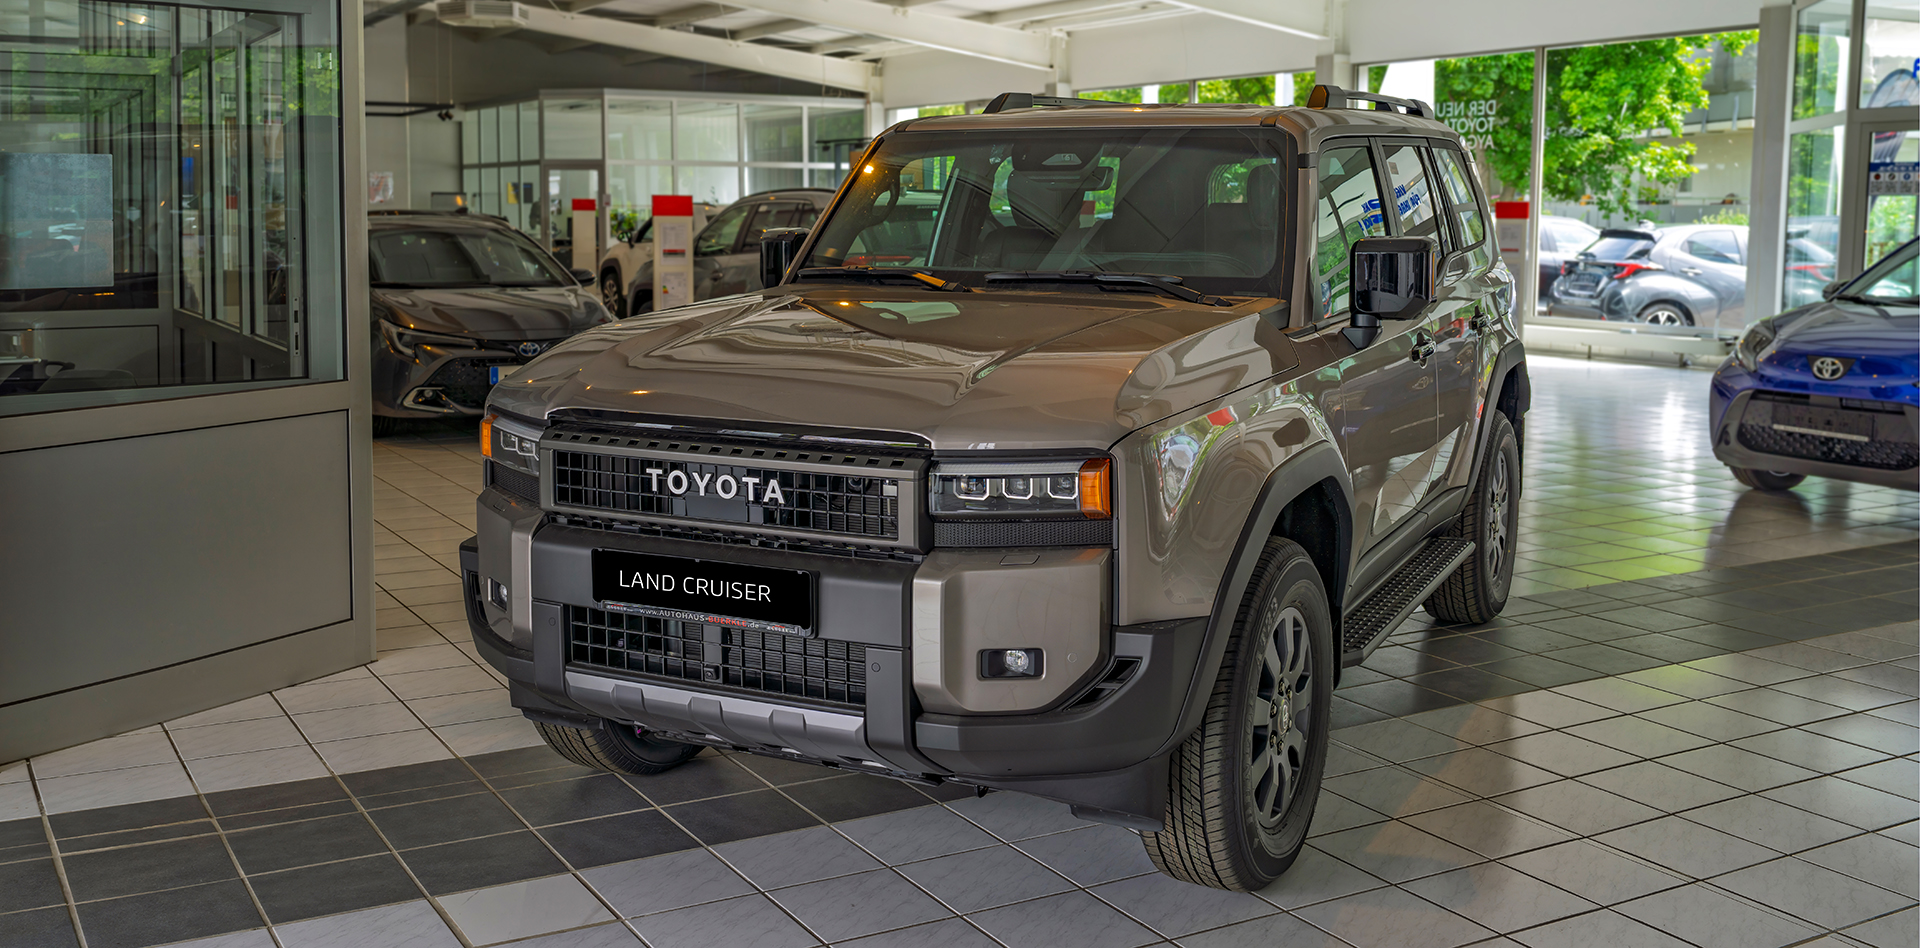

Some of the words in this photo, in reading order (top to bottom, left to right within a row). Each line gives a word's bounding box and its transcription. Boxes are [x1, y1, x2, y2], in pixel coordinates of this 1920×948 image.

[645, 467, 786, 505] TOYOTA
[619, 569, 676, 593] LAND
[682, 575, 772, 603] CRUISER
[639, 607, 760, 629] www.AUTOHAUS-BUERKLE.de
